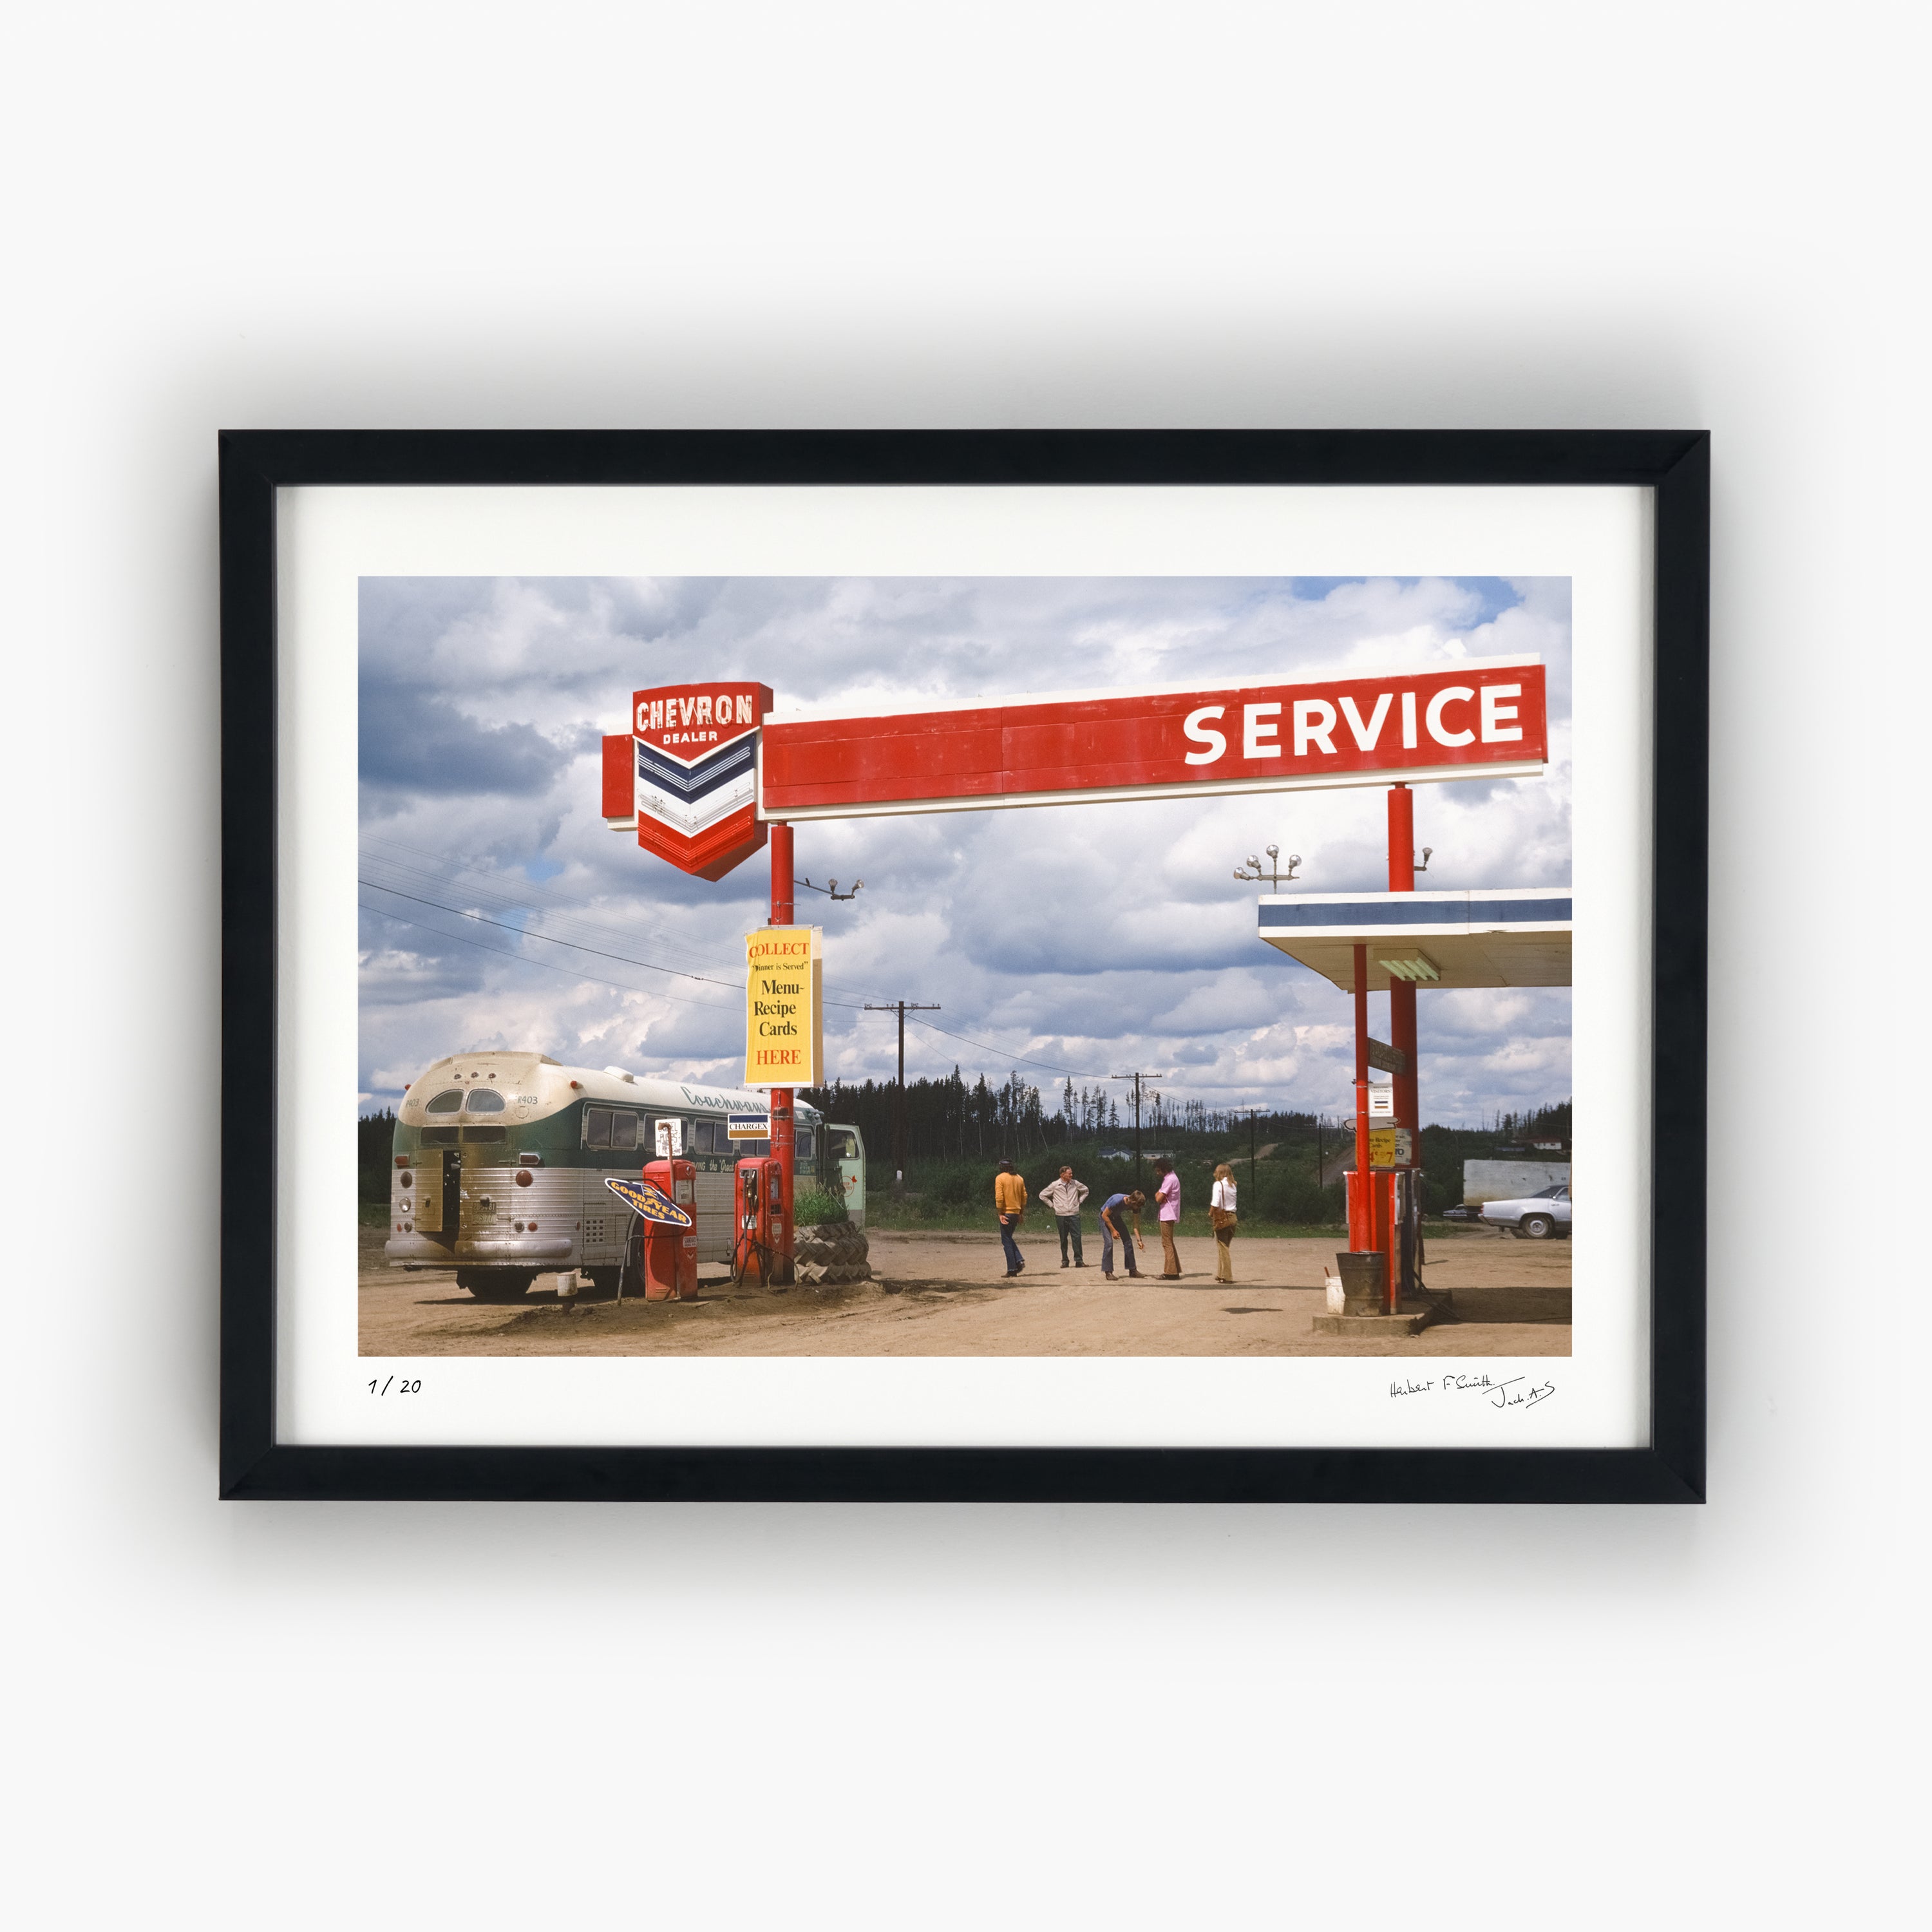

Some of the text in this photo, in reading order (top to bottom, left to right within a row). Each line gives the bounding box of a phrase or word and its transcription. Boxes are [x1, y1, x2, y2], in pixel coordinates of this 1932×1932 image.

[636, 695, 752, 732] CHEVRON
[1183, 683, 1523, 765] SERVICE
[663, 731, 717, 744] DEALER
[749, 942, 809, 958] COLLECT
[754, 999, 797, 1018] Recipe
[759, 1021, 797, 1037] Cards
[757, 1049, 801, 1065] HERE
[518, 1095, 538, 1105] R403
[611, 1182, 687, 1224] GOODYEAR
[632, 1198, 665, 1219] TIRES
